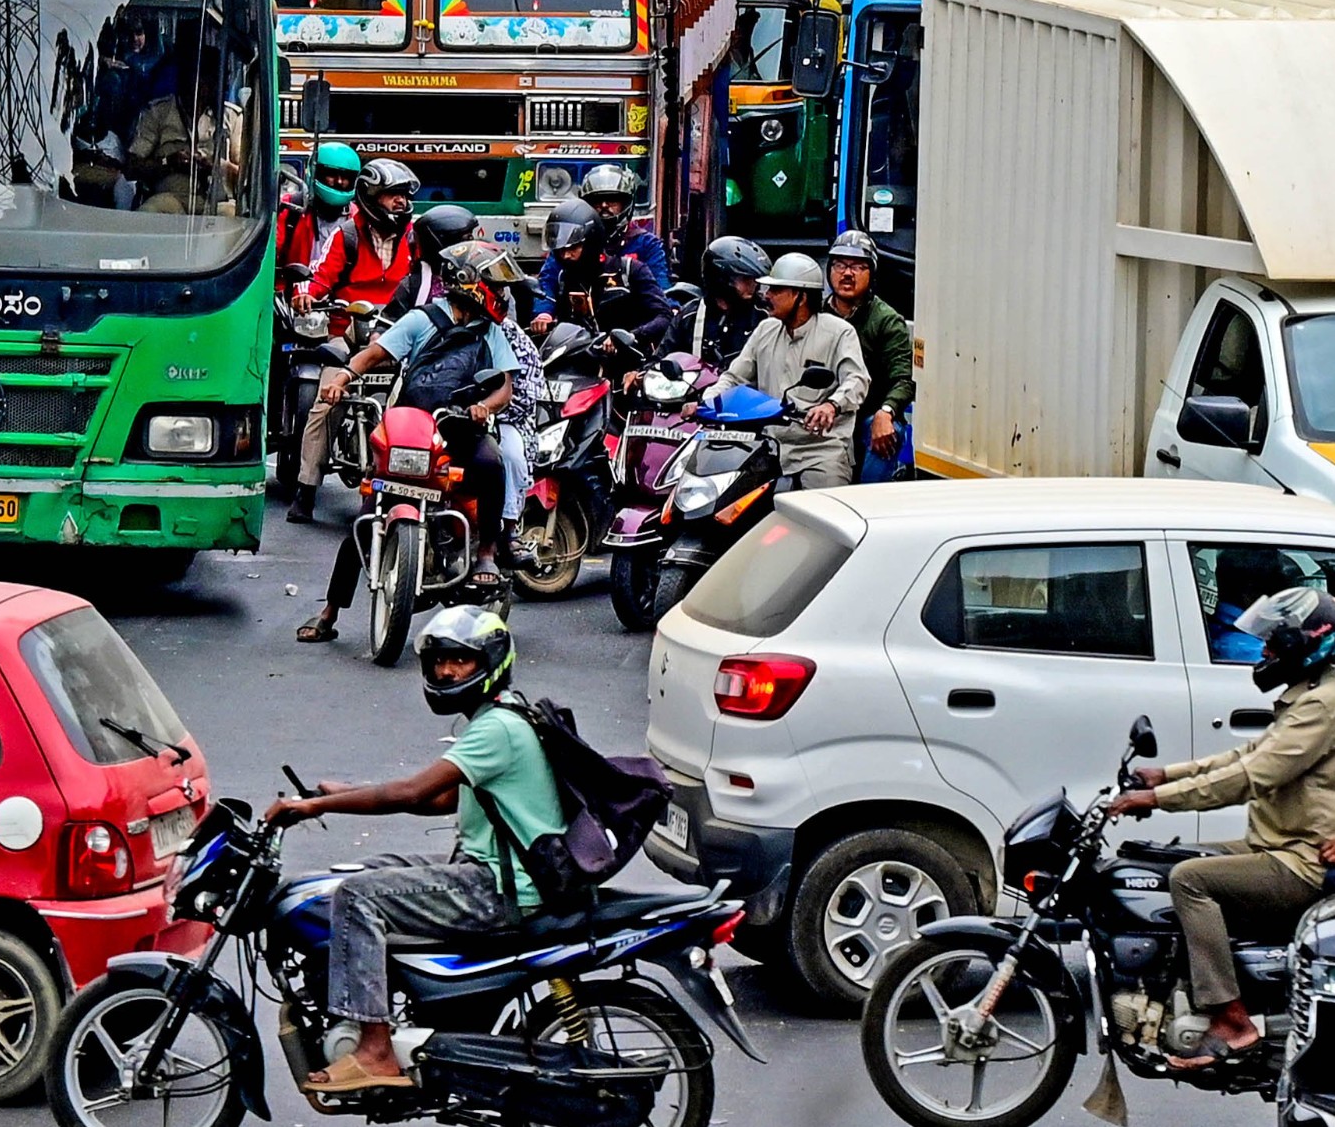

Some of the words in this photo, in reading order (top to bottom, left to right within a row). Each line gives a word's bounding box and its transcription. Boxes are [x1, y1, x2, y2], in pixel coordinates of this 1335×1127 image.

[383, 75, 458, 87] VALLIYAMMA
[355, 143, 410, 154] ASHOK
[415, 143, 486, 154] LEYLAND
[548, 147, 601, 155] TURBO
